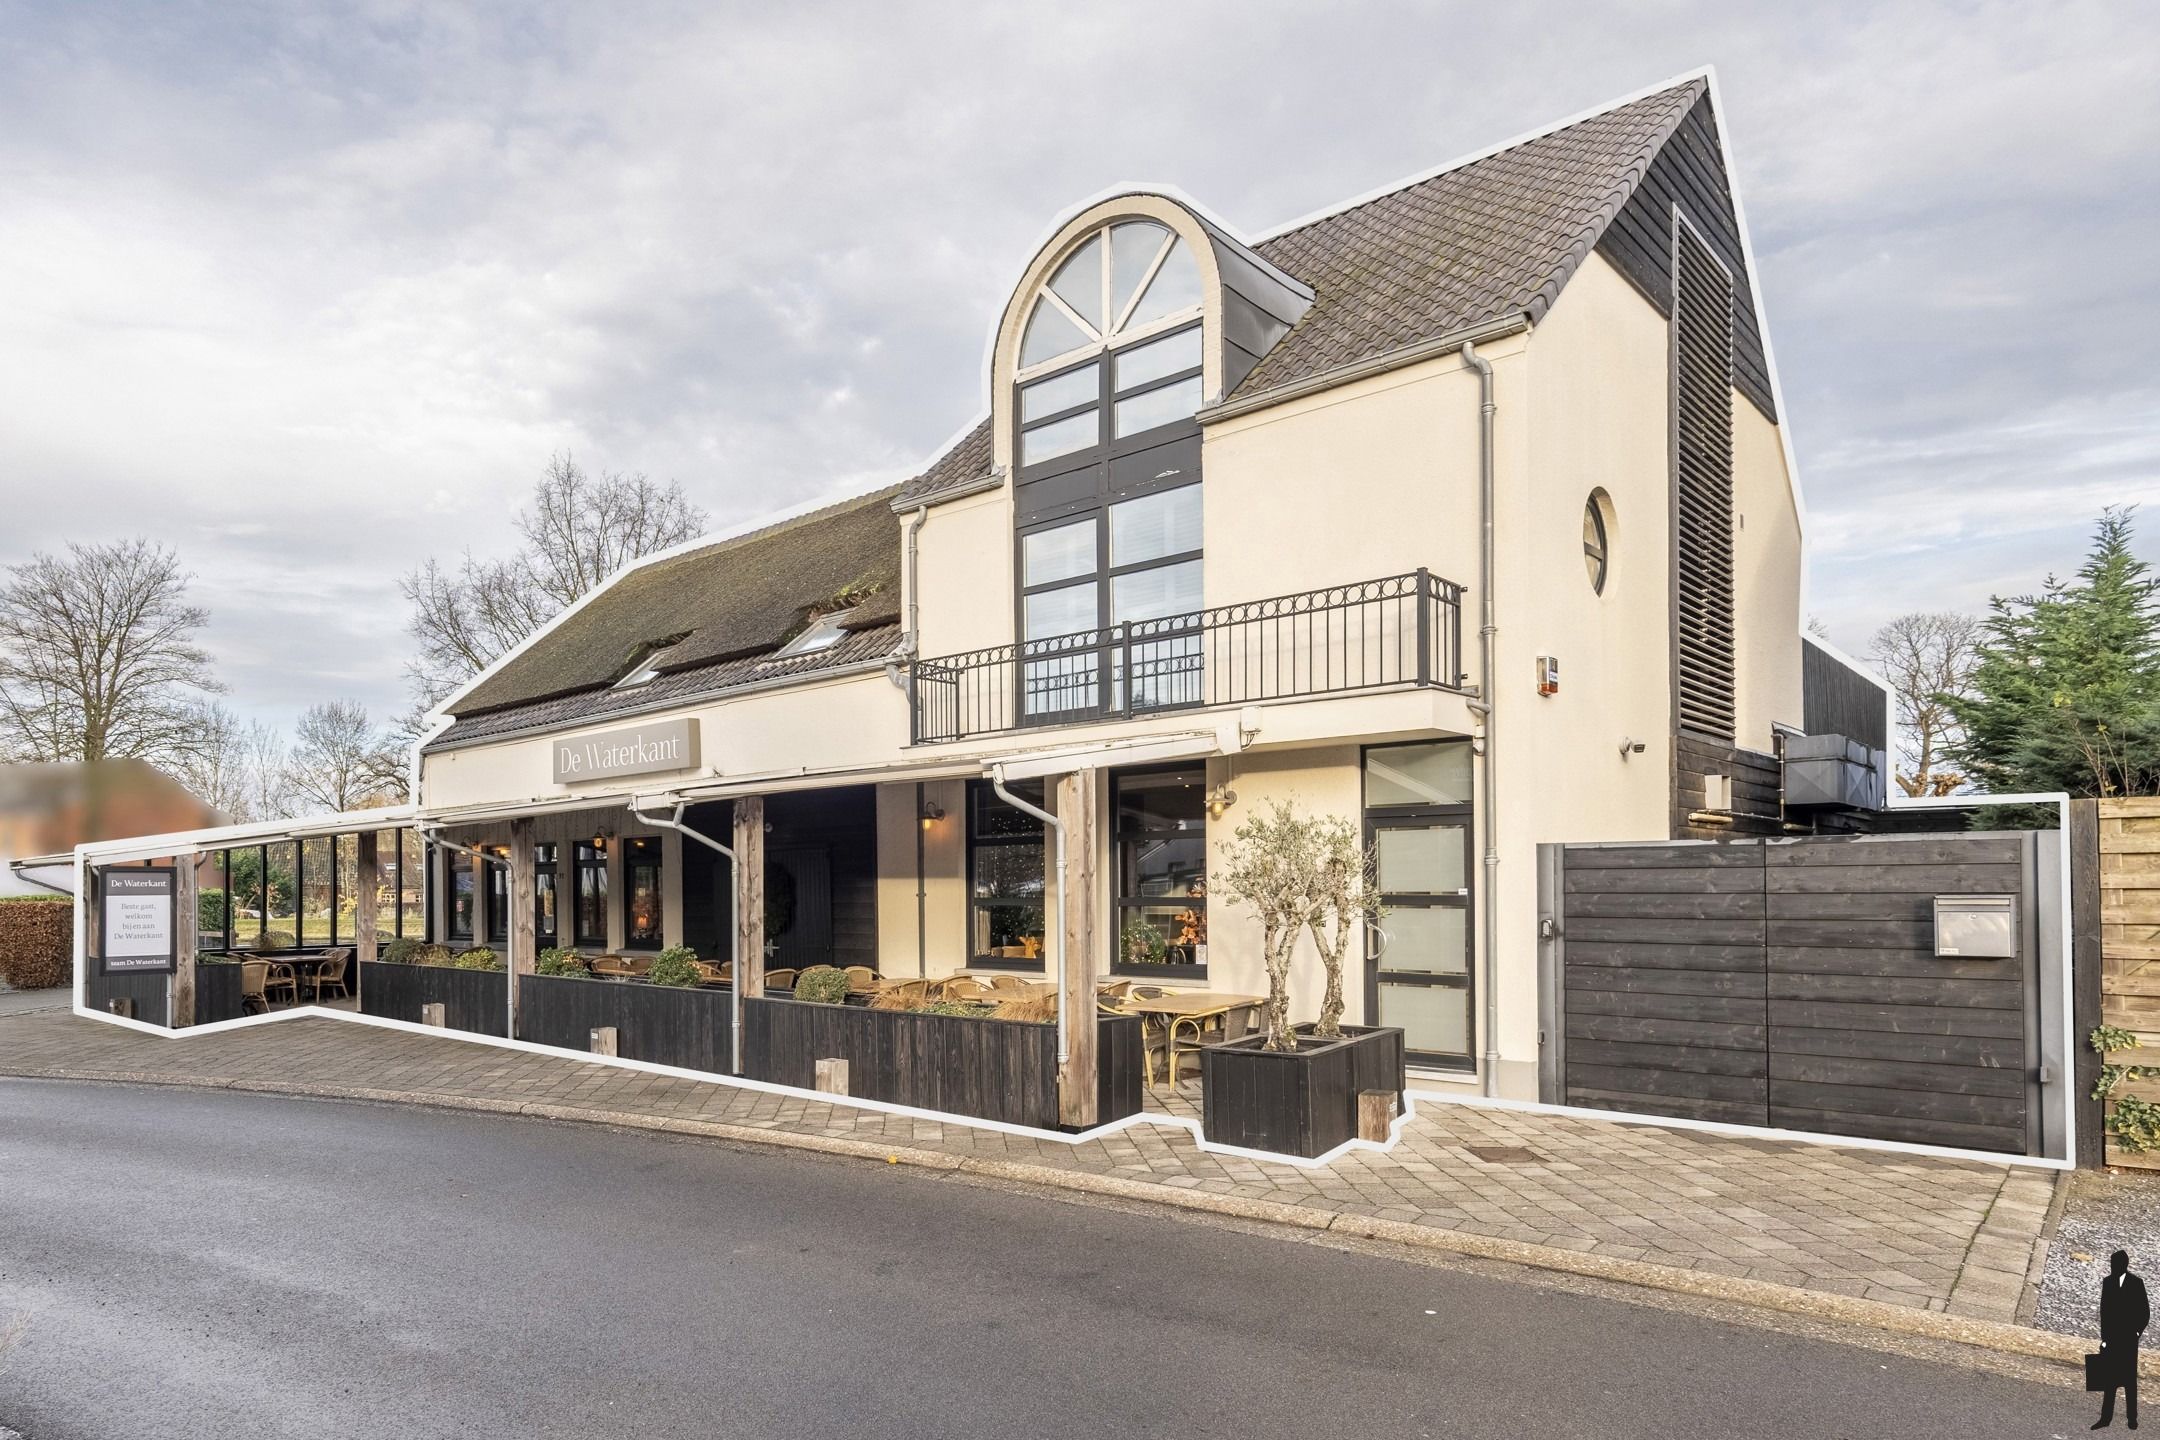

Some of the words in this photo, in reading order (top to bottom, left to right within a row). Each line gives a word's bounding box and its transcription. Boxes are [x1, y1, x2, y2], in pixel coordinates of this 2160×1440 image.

[560, 747, 581, 774] De
[585, 734, 681, 770] Waterkant
[125, 912, 153, 920] welkom
